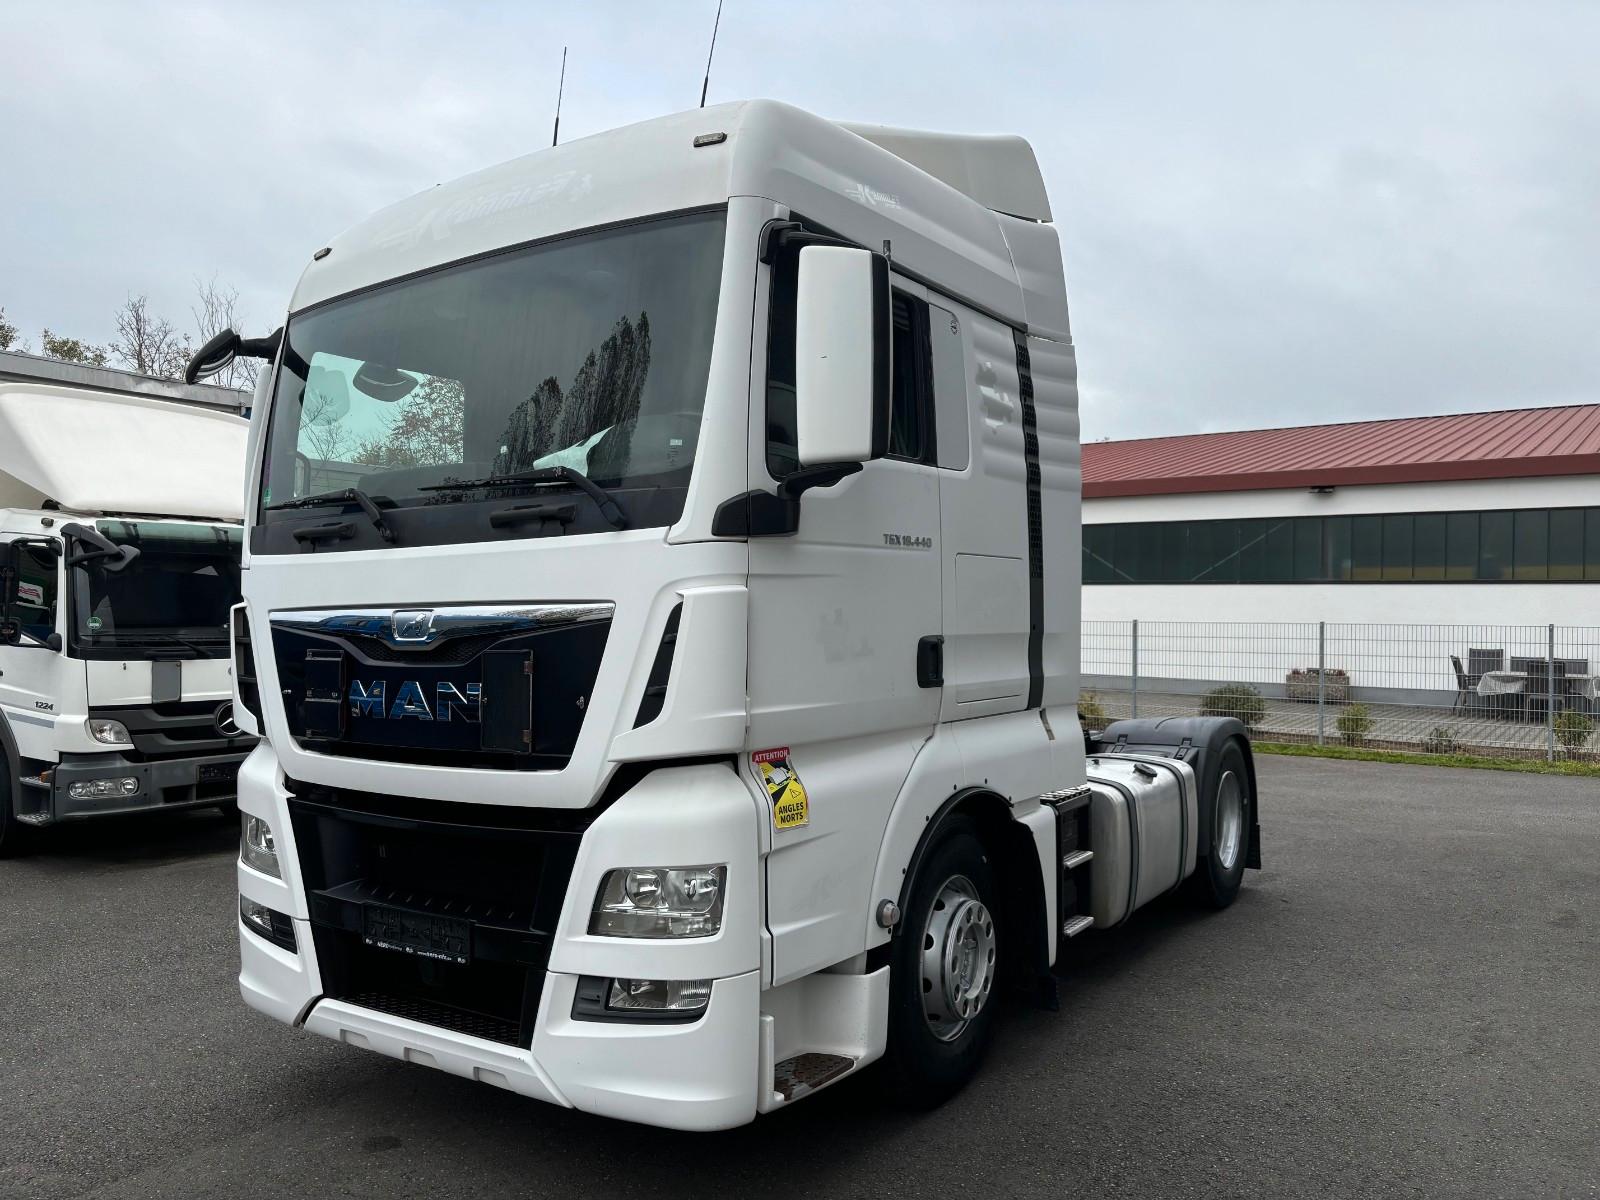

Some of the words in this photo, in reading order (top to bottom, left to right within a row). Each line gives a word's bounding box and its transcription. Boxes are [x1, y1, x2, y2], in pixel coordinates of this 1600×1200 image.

[883, 534, 901, 546] TGX
[35, 701, 54, 711] 1224
[350, 679, 482, 722] MAN
[754, 749, 789, 762] ATTENTION
[778, 802, 804, 815] ANGLES
[780, 811, 804, 824] MORTS
